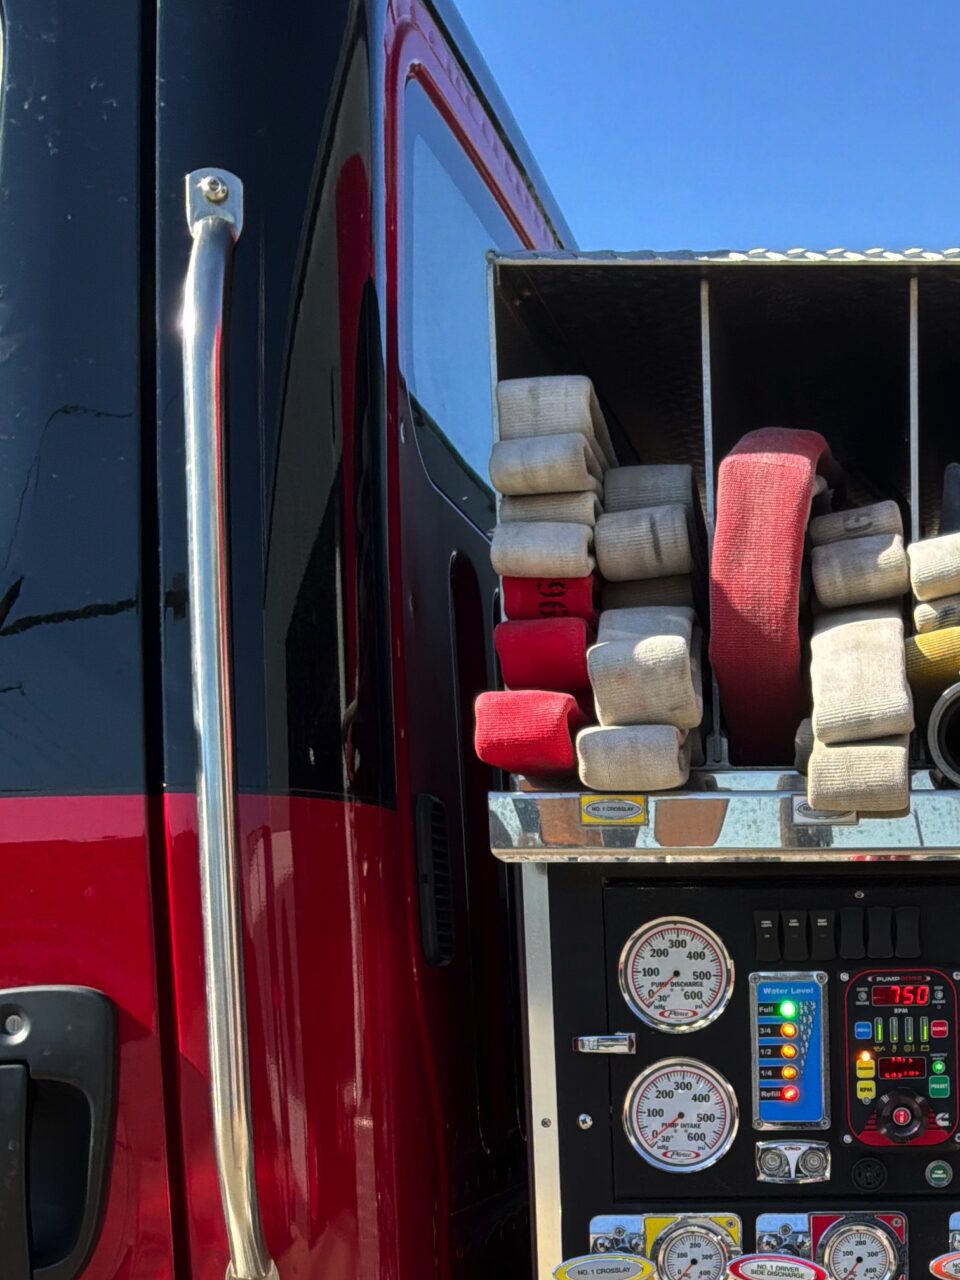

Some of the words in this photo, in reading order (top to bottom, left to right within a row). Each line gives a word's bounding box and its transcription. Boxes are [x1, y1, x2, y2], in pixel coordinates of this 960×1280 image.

[668, 940, 686, 948] 300
[650, 948, 669, 957] 200
[687, 951, 705, 960] 400
[642, 968, 659, 976] 100
[693, 971, 711, 980] 500
[648, 990, 654, 998] 0
[684, 991, 702, 1000] 600
[891, 986, 929, 1004] 750
[674, 1082, 692, 1090] 300
[656, 1090, 674, 1098] 200
[692, 1094, 710, 1102] 400
[647, 1109, 664, 1117] 100
[697, 1114, 715, 1122] 500
[652, 1130, 658, 1138] 0
[688, 1133, 705, 1141] 600
[767, 1271, 805, 1279] DISCHARGE
